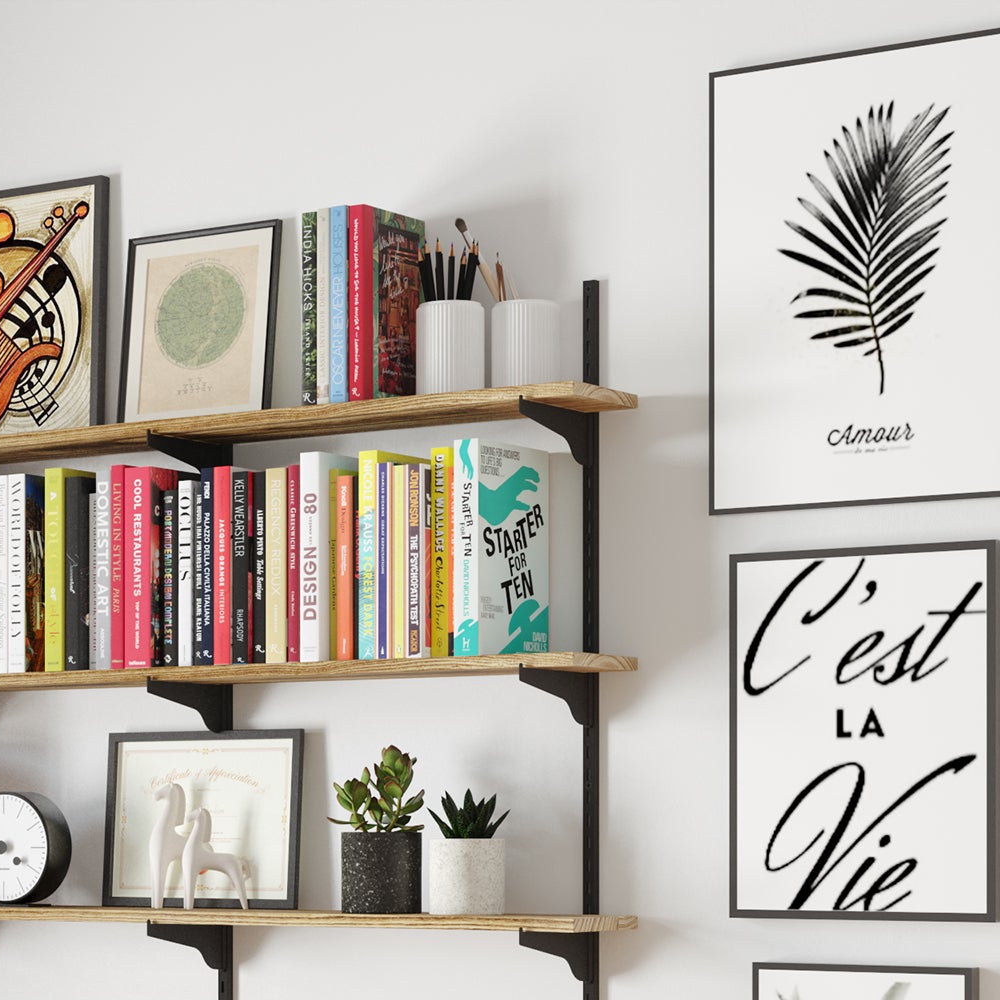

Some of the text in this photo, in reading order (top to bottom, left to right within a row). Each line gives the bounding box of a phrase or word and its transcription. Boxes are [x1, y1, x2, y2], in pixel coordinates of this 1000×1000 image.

[303, 225, 313, 263] INDIA
[303, 268, 313, 311] HICKS
[333, 224, 344, 385] OSCAR NIEMEYER HOUSES
[827, 422, 915, 446] Amour
[133, 479, 142, 510] COOL
[271, 479, 282, 545] REGENCY
[459, 522, 467, 535] FOR
[461, 482, 473, 527] STARTER
[483, 504, 544, 557] STARTER
[11, 481, 22, 639] WORLD OF FOLLY
[97, 481, 109, 617] DOMESTIC ART
[113, 483, 122, 613] LIVING IN STYLE PARIS
[133, 513, 142, 597] RESTAURANTS
[180, 496, 191, 581] OCULUS
[234, 479, 244, 642] KELLY WEARSTLER RHAPSODY
[256, 509, 264, 601] ALBERTO PINTO Table Settings
[271, 549, 282, 596] REDUX
[304, 493, 317, 621] DESIGN 80
[363, 459, 373, 637] NICOLE KRAUSS FOREST DARK
[410, 470, 419, 652] JON RONSON THE PSYCHOPATH TEST PICADOR
[435, 455, 445, 631] DANNY WALLACE Charlotte Street
[462, 535, 473, 557] TEN
[508, 553, 527, 577] FOR
[164, 510, 173, 645] POSTMODERN DESIGN COMPLETE
[500, 569, 534, 615] TEN
[523, 641, 547, 652] NICHOLLS
[533, 632, 547, 642] DAVID
[743, 558, 986, 696] C'est
[836, 708, 885, 738] LA
[765, 754, 977, 911] Vie
